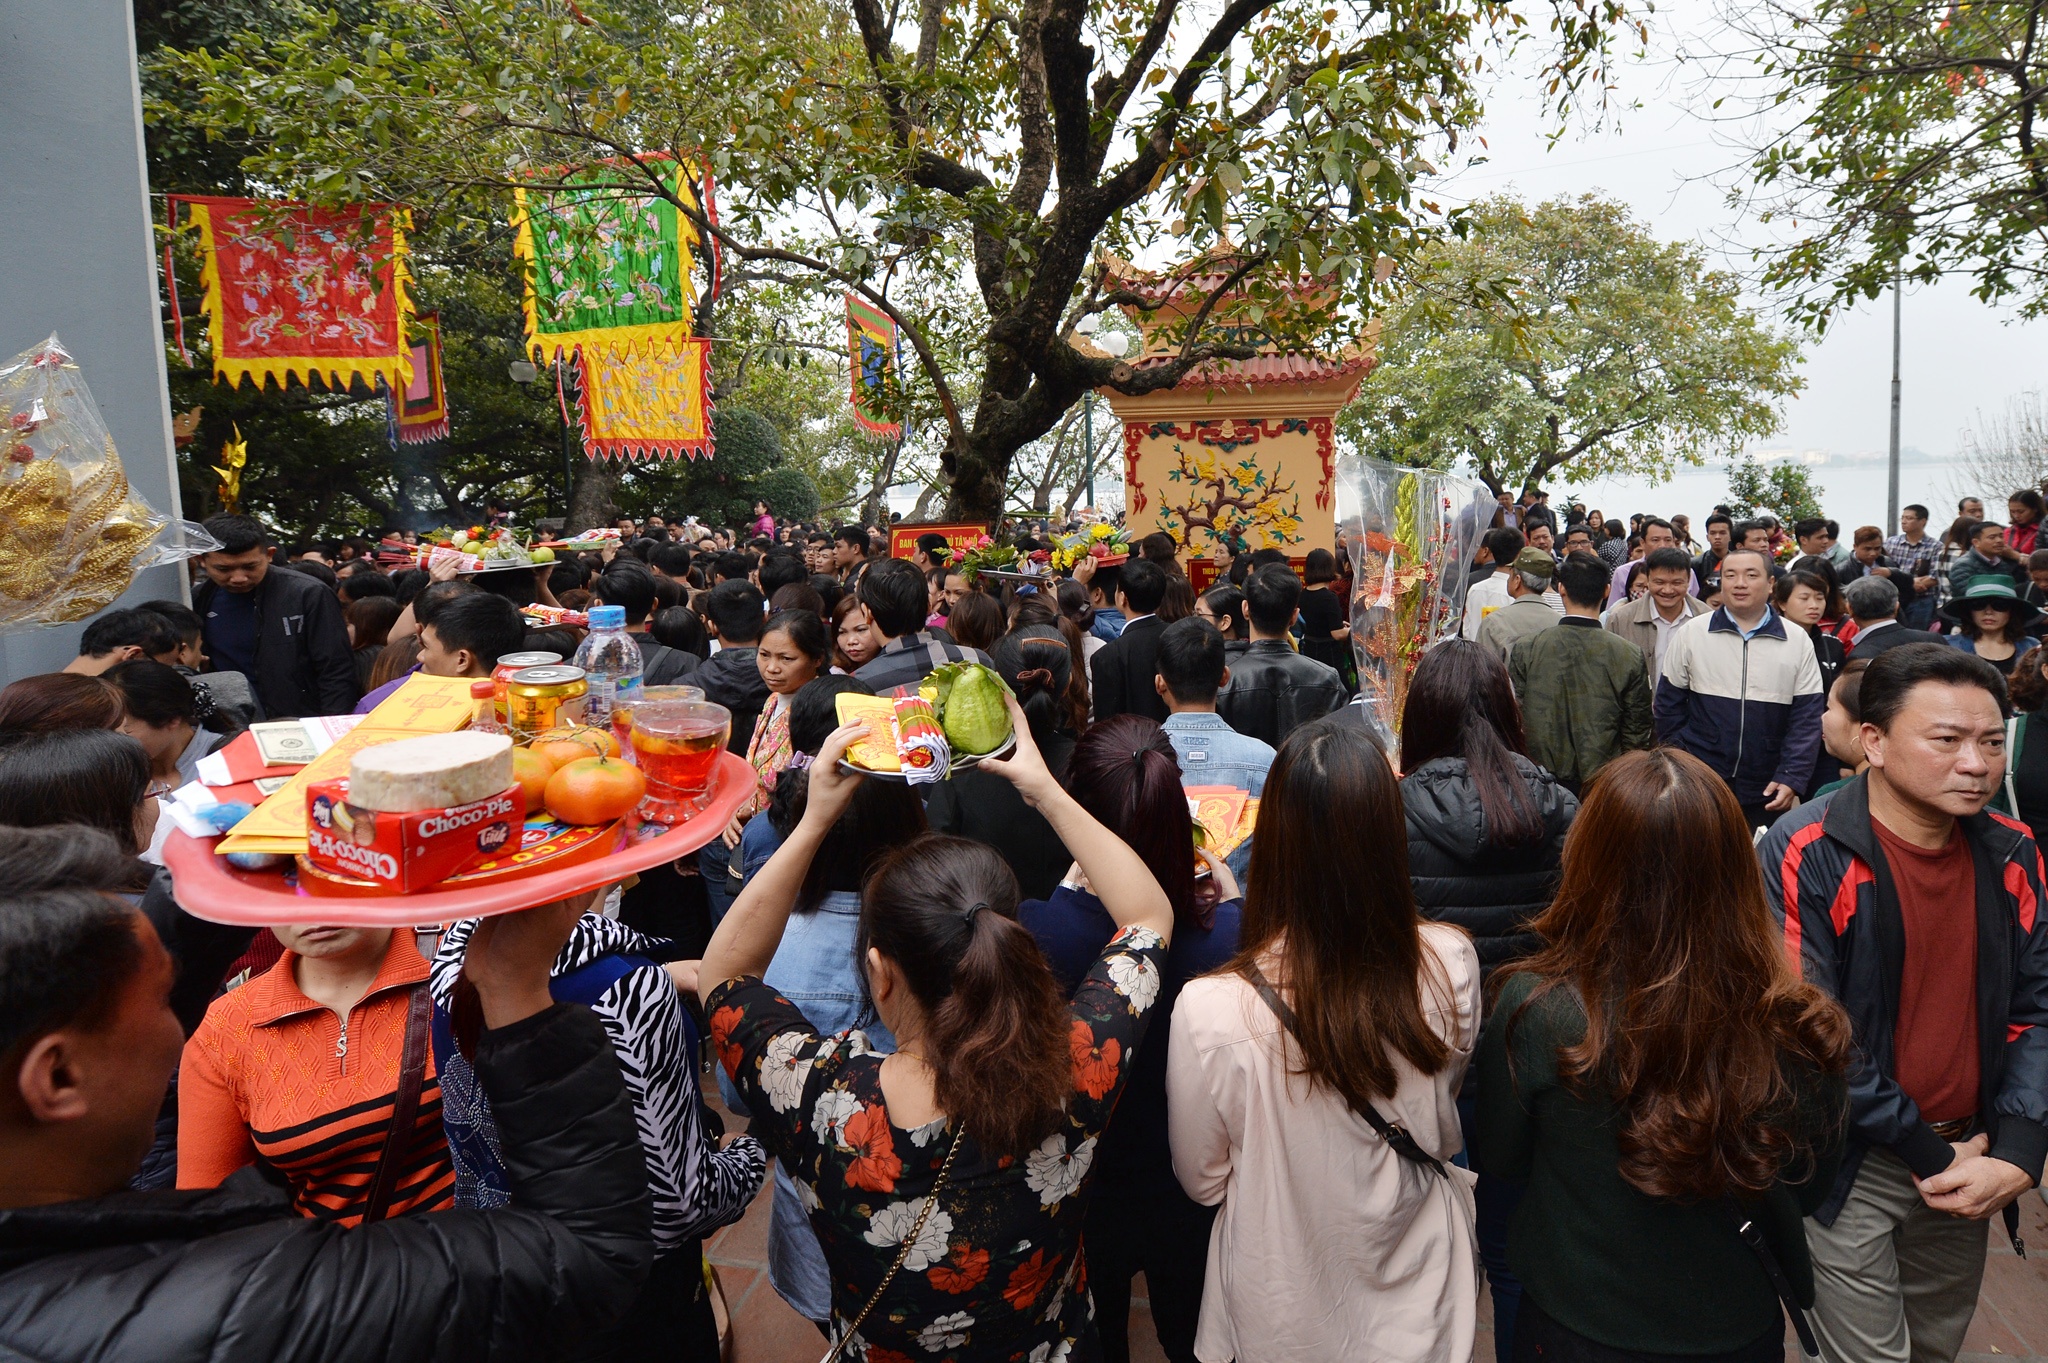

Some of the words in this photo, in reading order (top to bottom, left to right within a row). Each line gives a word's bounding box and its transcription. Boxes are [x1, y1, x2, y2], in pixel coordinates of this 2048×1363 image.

[899, 538, 912, 548] BAN
[1202, 567, 1215, 575] THEO
[282, 614, 304, 636] 17
[418, 797, 513, 838] Choco-Pie
